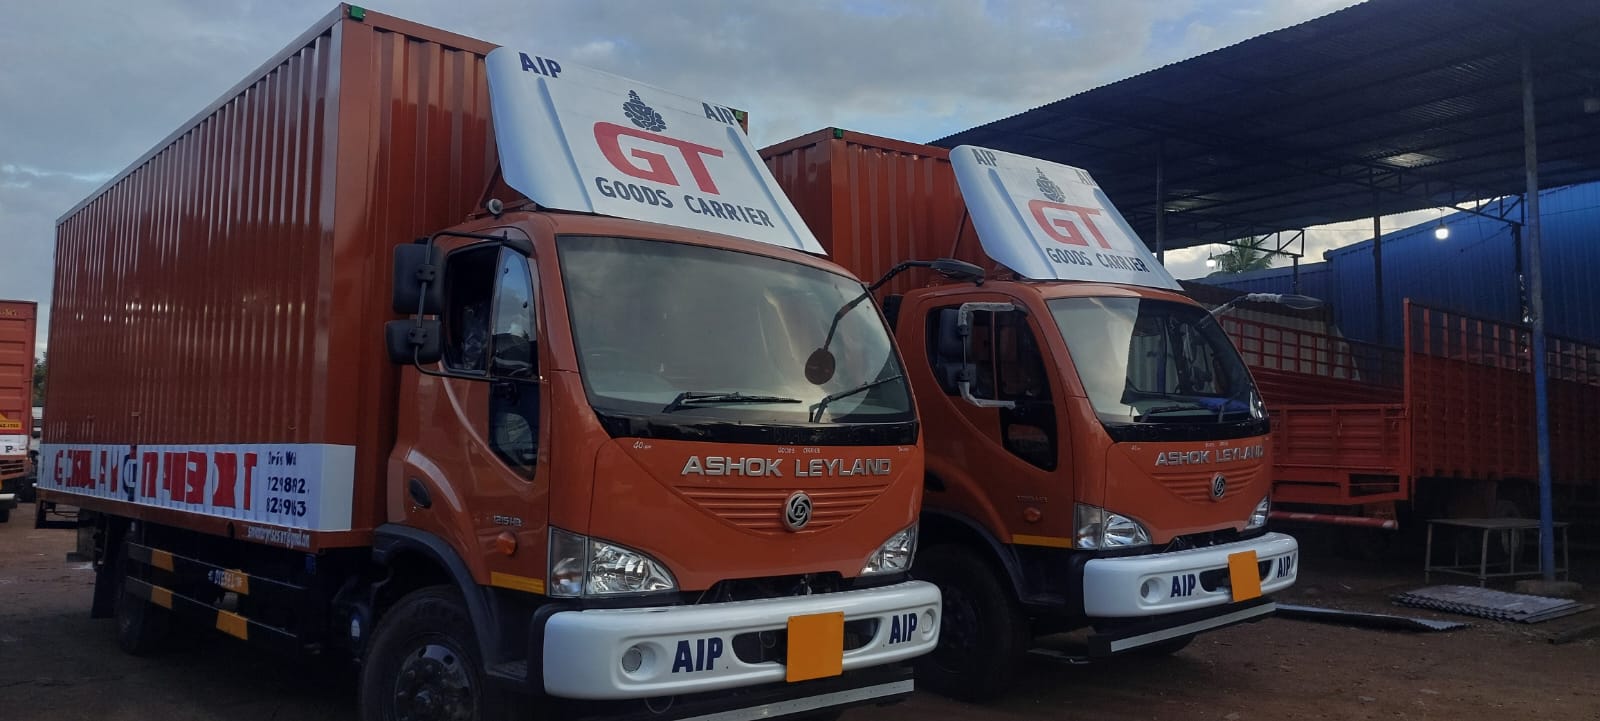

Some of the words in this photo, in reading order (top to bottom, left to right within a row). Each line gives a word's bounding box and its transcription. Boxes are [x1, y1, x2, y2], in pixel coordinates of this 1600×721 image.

[519, 52, 561, 78] AIP
[702, 102, 736, 125] AIP
[594, 121, 724, 195] GT
[972, 149, 996, 167] AIP
[595, 176, 674, 208] GOODS
[684, 195, 774, 228] CARRIER
[1028, 199, 1112, 249] GT
[1046, 248, 1093, 267] GOODS
[1096, 253, 1149, 272] CARRIER
[681, 455, 784, 478] ASHOK
[795, 457, 891, 478] LEYLAND
[1155, 450, 1211, 466] ASHOK
[1215, 445, 1264, 462] LEYLAND
[1277, 556, 1291, 578] AIP
[1170, 574, 1196, 597] AIP
[889, 612, 918, 645] AIP
[672, 637, 723, 673] AIP
